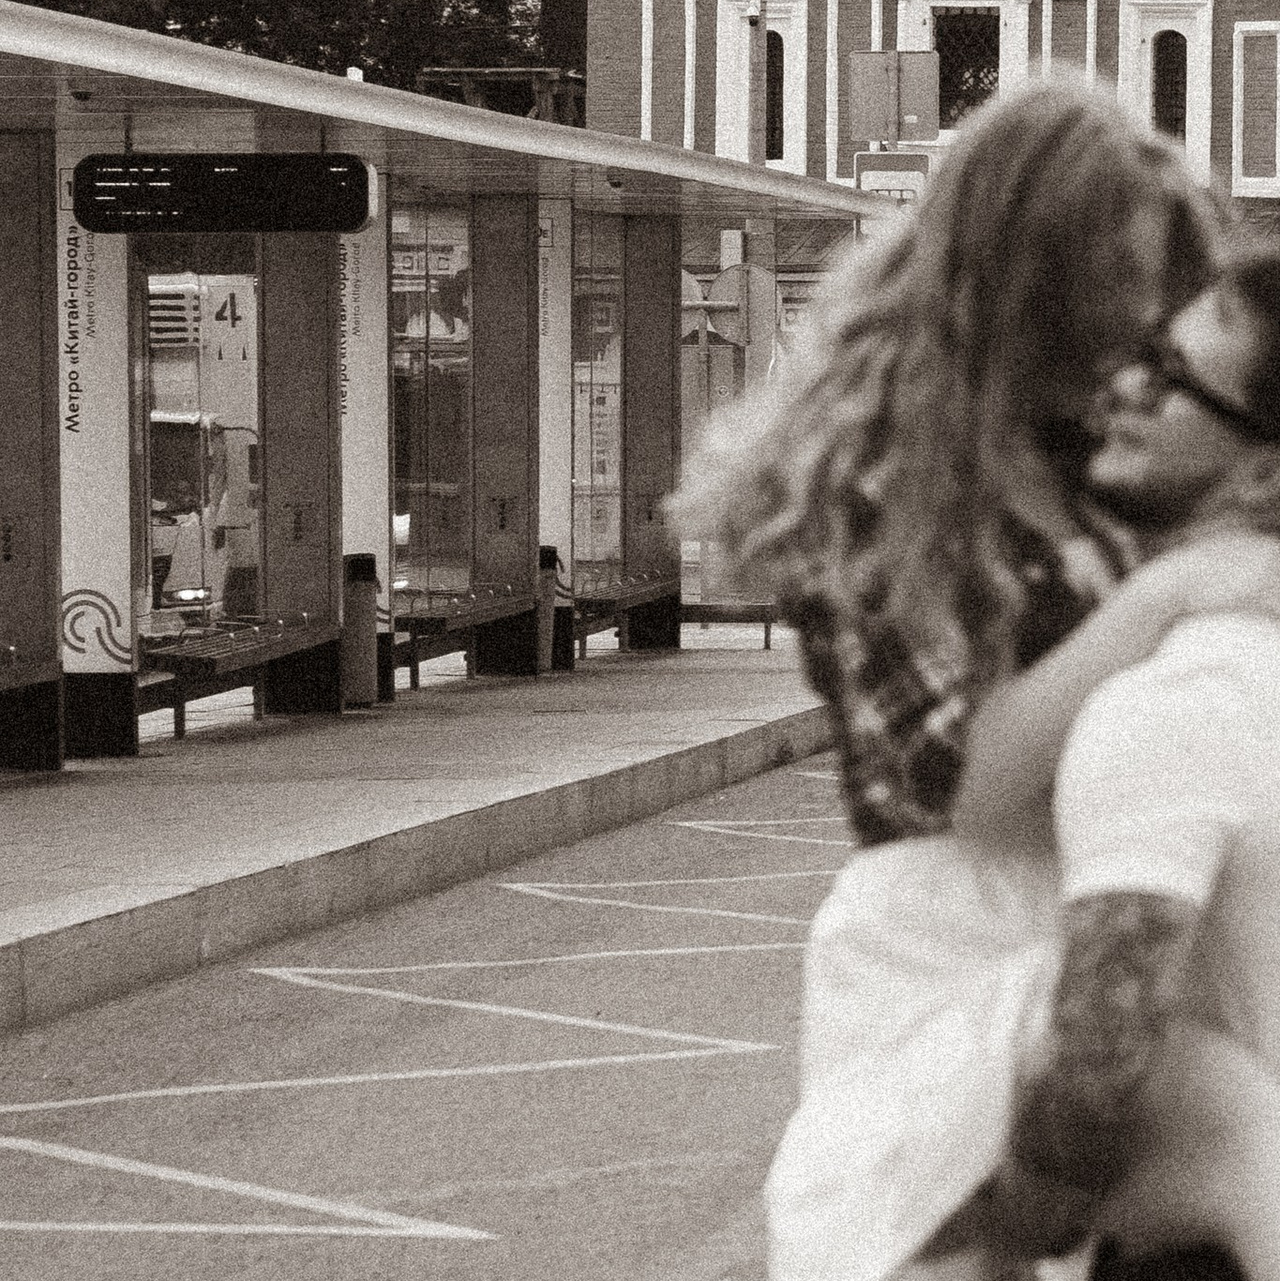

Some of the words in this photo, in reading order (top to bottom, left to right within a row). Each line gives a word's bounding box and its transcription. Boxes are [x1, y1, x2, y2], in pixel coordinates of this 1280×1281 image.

[85, 231, 97, 299] Kitay-Goro
[86, 301, 96, 339] Metro
[214, 293, 242, 328] 4
[65, 370, 83, 434] Метро
